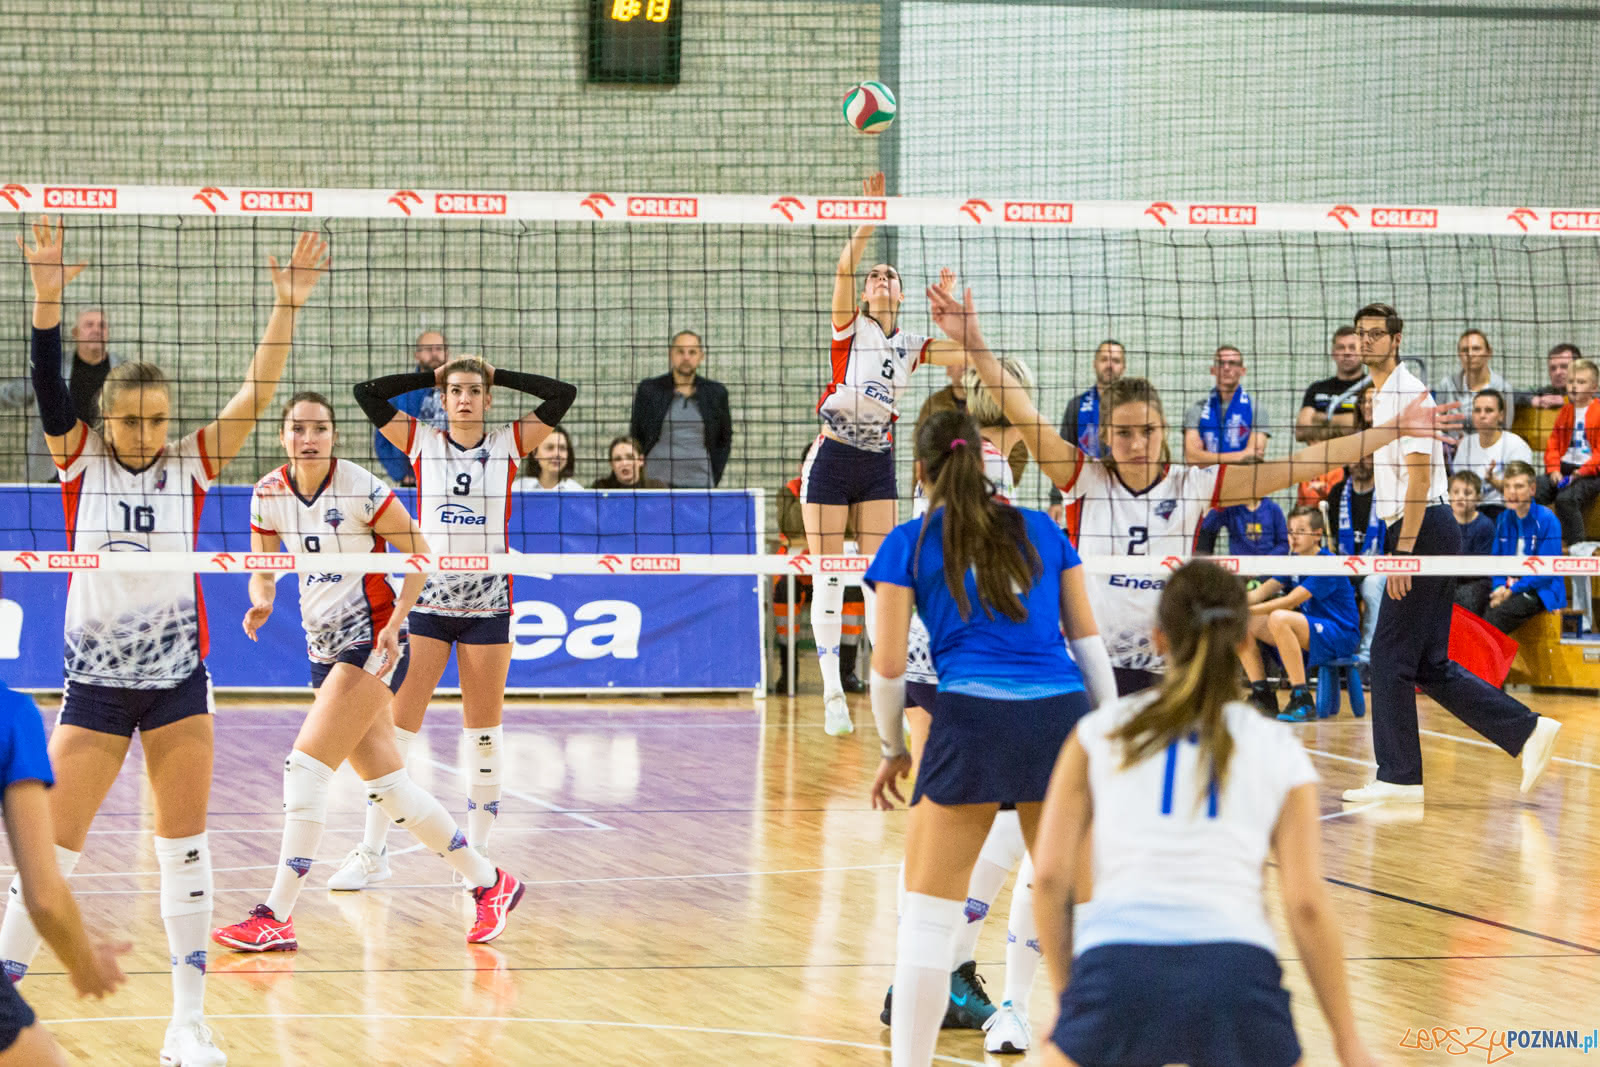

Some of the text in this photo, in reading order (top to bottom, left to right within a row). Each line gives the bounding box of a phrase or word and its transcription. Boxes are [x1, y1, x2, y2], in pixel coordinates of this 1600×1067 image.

[46, 189, 115, 207] ORLEN
[242, 192, 310, 211] ORLEN
[437, 195, 505, 213] ORLEN
[630, 198, 695, 216] ORLEN
[819, 201, 884, 219] ORLEN
[1006, 204, 1070, 222] ORLEN
[1191, 206, 1254, 223] ORLEN
[1373, 209, 1436, 227] ORLEN
[1552, 212, 1600, 230] ORLE
[881, 358, 894, 380] 5
[452, 472, 472, 496] 9
[118, 501, 155, 533] 16
[440, 510, 487, 525] Enea
[1127, 526, 1148, 555] 2
[50, 555, 98, 567] ORLEN
[246, 556, 294, 569] ORLEN
[440, 556, 487, 570] ORLEN
[633, 558, 679, 570] ORLEN
[822, 558, 868, 571] ORLEN
[1375, 559, 1419, 572] ORLEN
[1108, 574, 1165, 590] Enea
